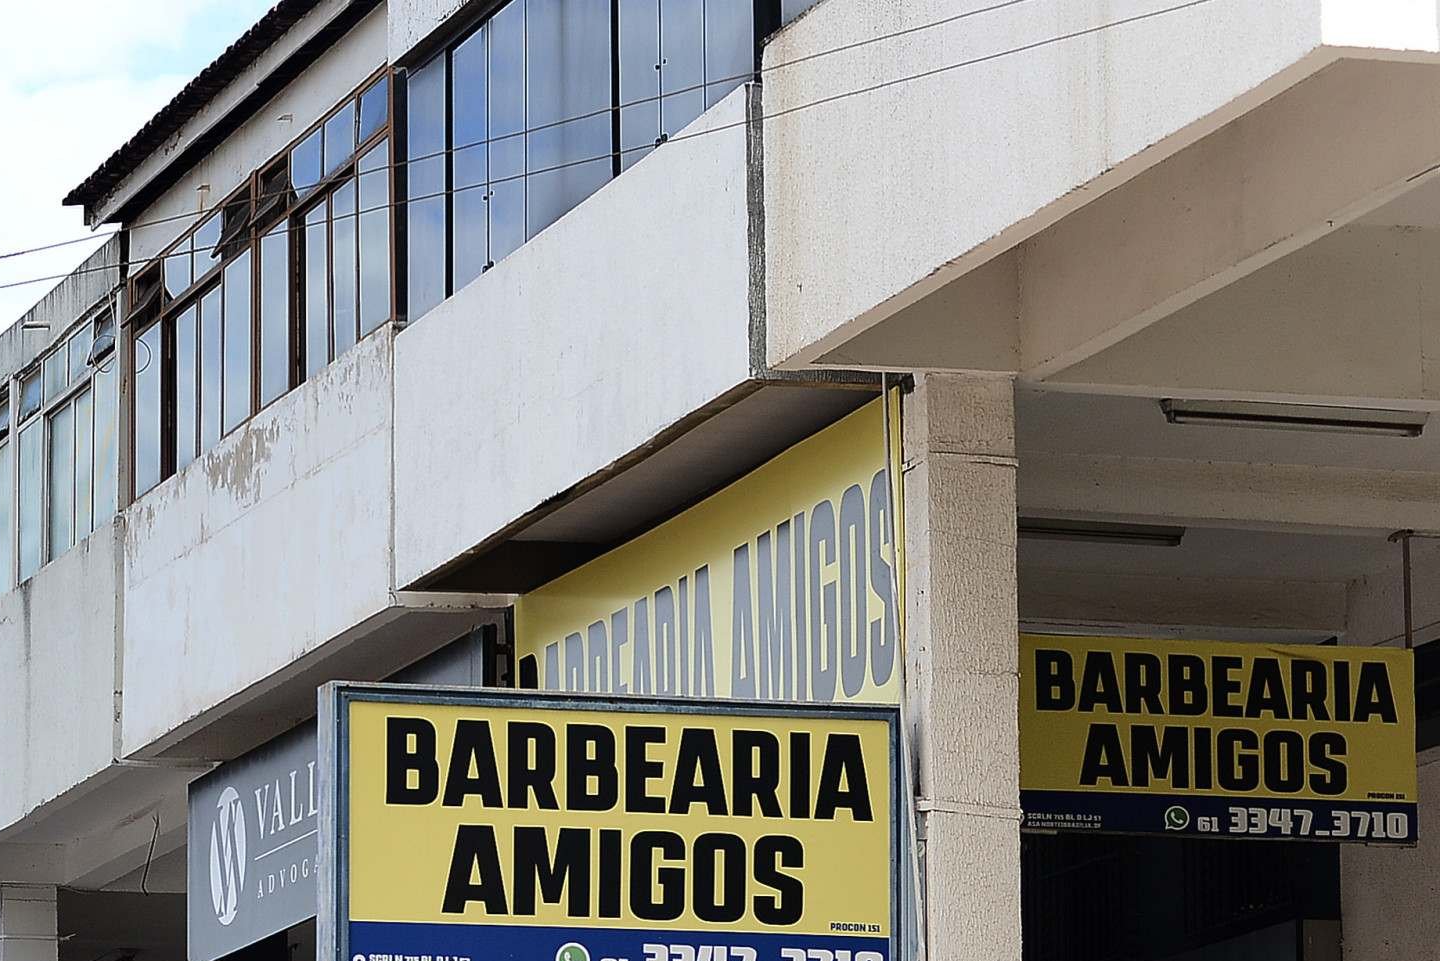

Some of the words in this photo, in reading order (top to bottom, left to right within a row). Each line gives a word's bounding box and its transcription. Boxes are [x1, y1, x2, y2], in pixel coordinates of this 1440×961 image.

[1034, 648, 1398, 723] BARBEARIA
[385, 716, 873, 822] BARBEARIA
[1079, 722, 1348, 795] AMIGOS
[1197, 816, 1220, 832] 61
[441, 824, 804, 926] AMIGOS
[830, 922, 866, 932] PROCON
[868, 924, 881, 933] 151
